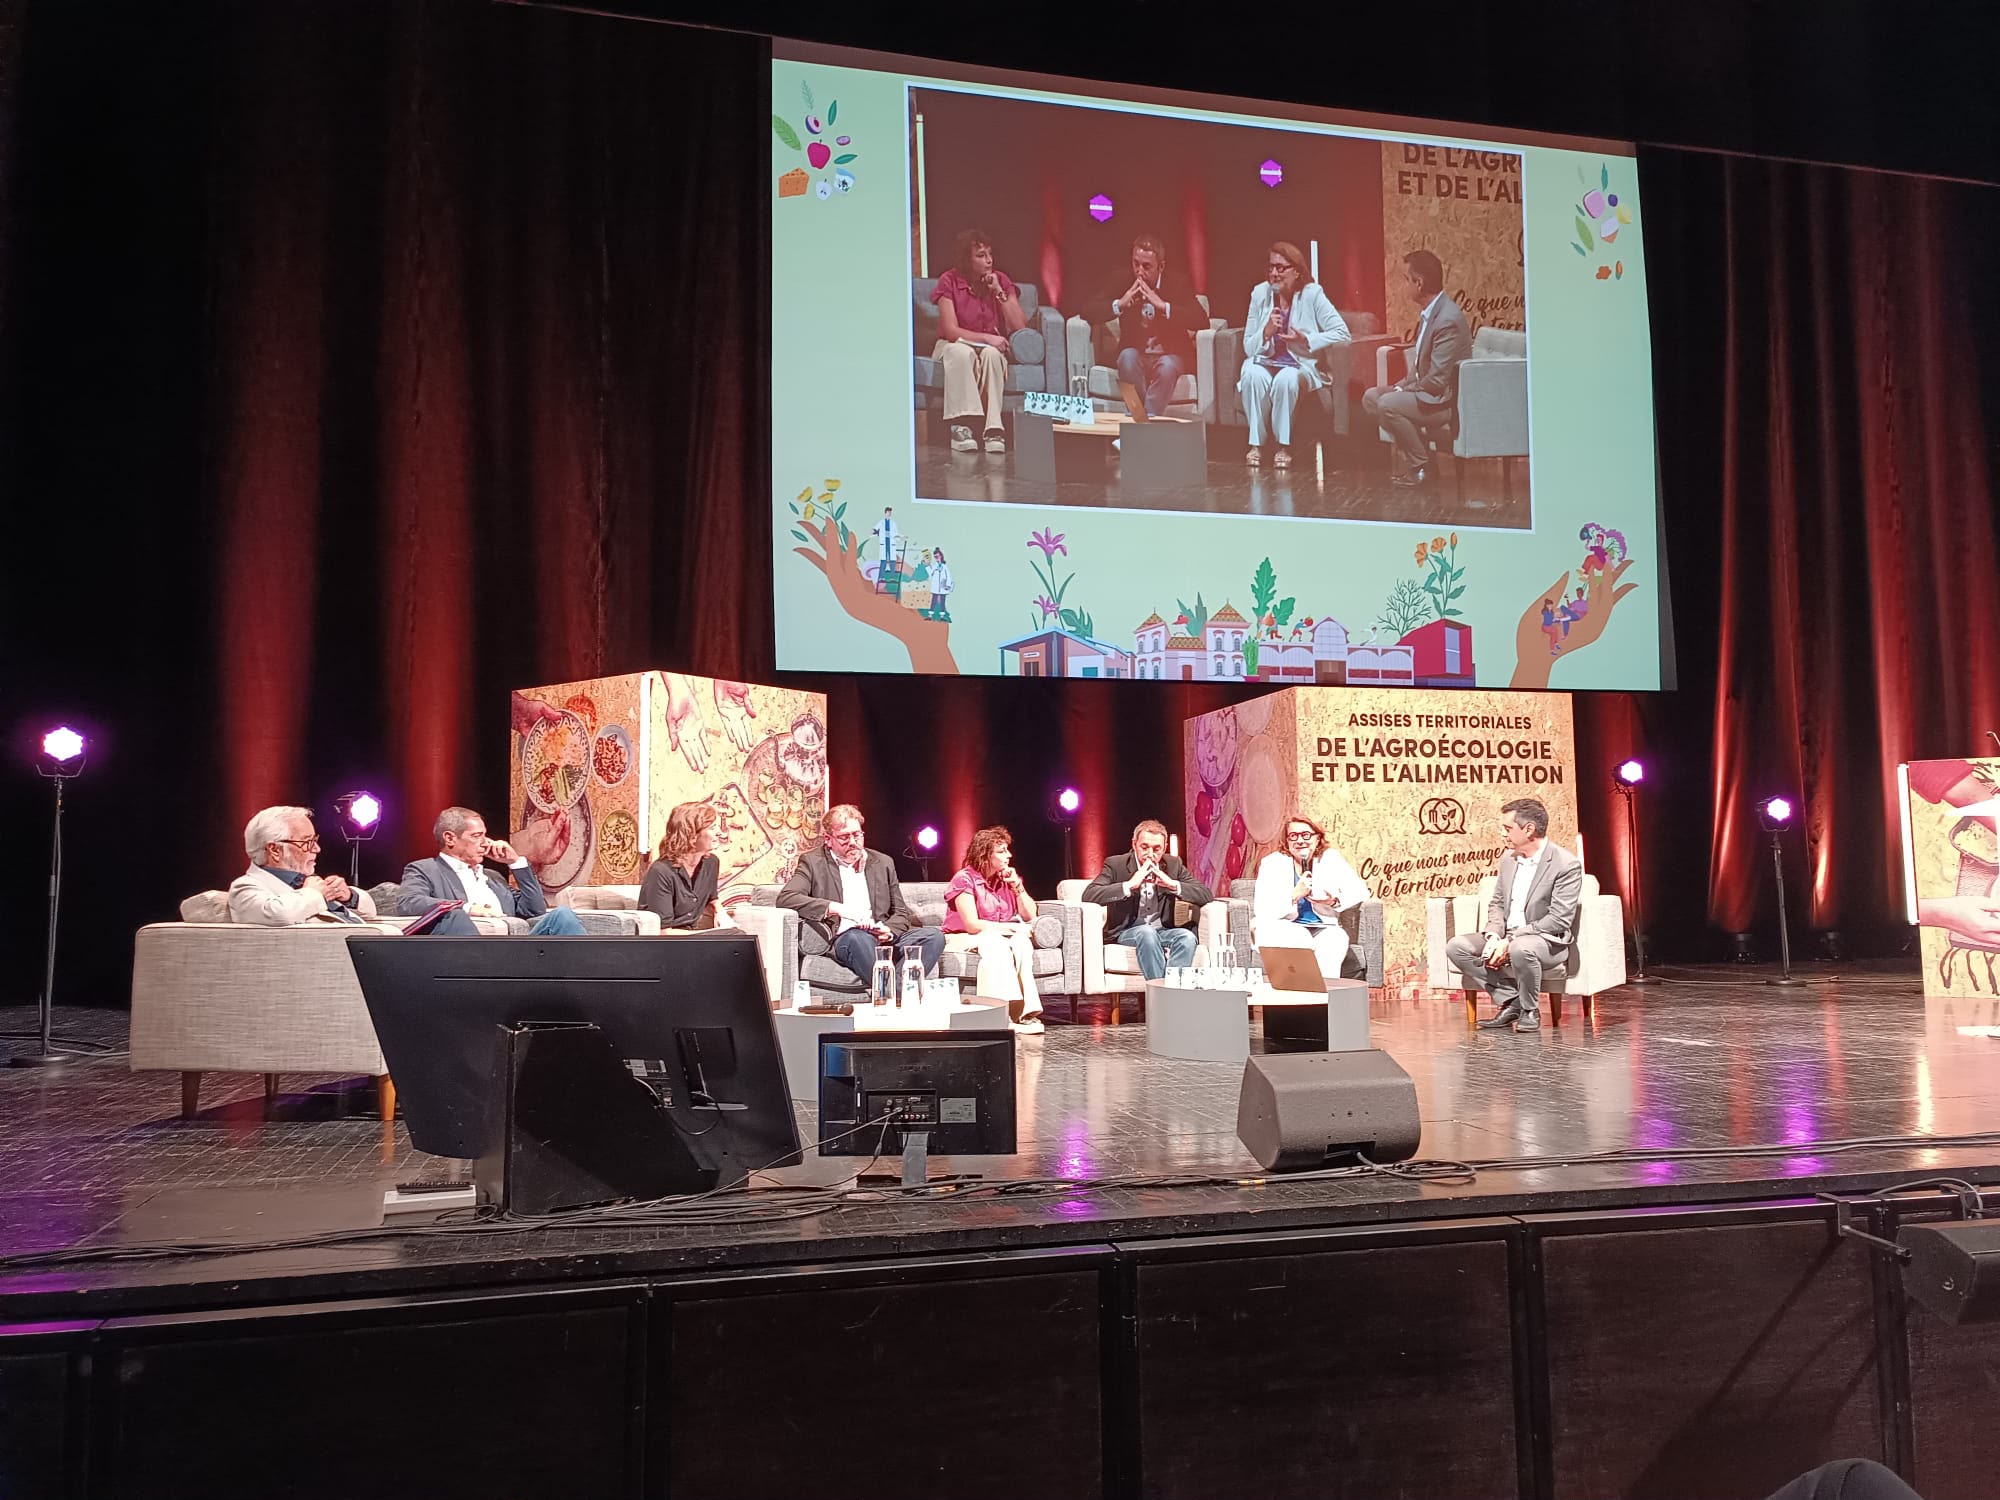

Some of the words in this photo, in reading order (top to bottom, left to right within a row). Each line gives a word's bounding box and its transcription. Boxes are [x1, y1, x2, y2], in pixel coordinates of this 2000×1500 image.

[1404, 143, 1437, 166] DE
[1445, 147, 1522, 173] L'AGR
[1398, 170, 1428, 195] ET
[1436, 174, 1469, 199] DE
[1453, 289, 1475, 313] Ce
[1477, 296, 1514, 320] que
[1348, 713, 1411, 728] ASSISES
[1416, 714, 1532, 730] TERRITORIALES
[1317, 737, 1347, 757] DE
[1355, 733, 1552, 759] L'AGROÉCOLOGIE
[1312, 763, 1339, 782] ET
[1346, 763, 1375, 783] DE
[1383, 763, 1563, 784] L'ALIMENTATION
[1360, 857, 1381, 880] Ce
[1383, 861, 1413, 882] que
[1416, 854, 1449, 870] nous
[1452, 846, 1509, 867] mange
[1377, 879, 1393, 899] le
[1394, 872, 1464, 897] territoire
